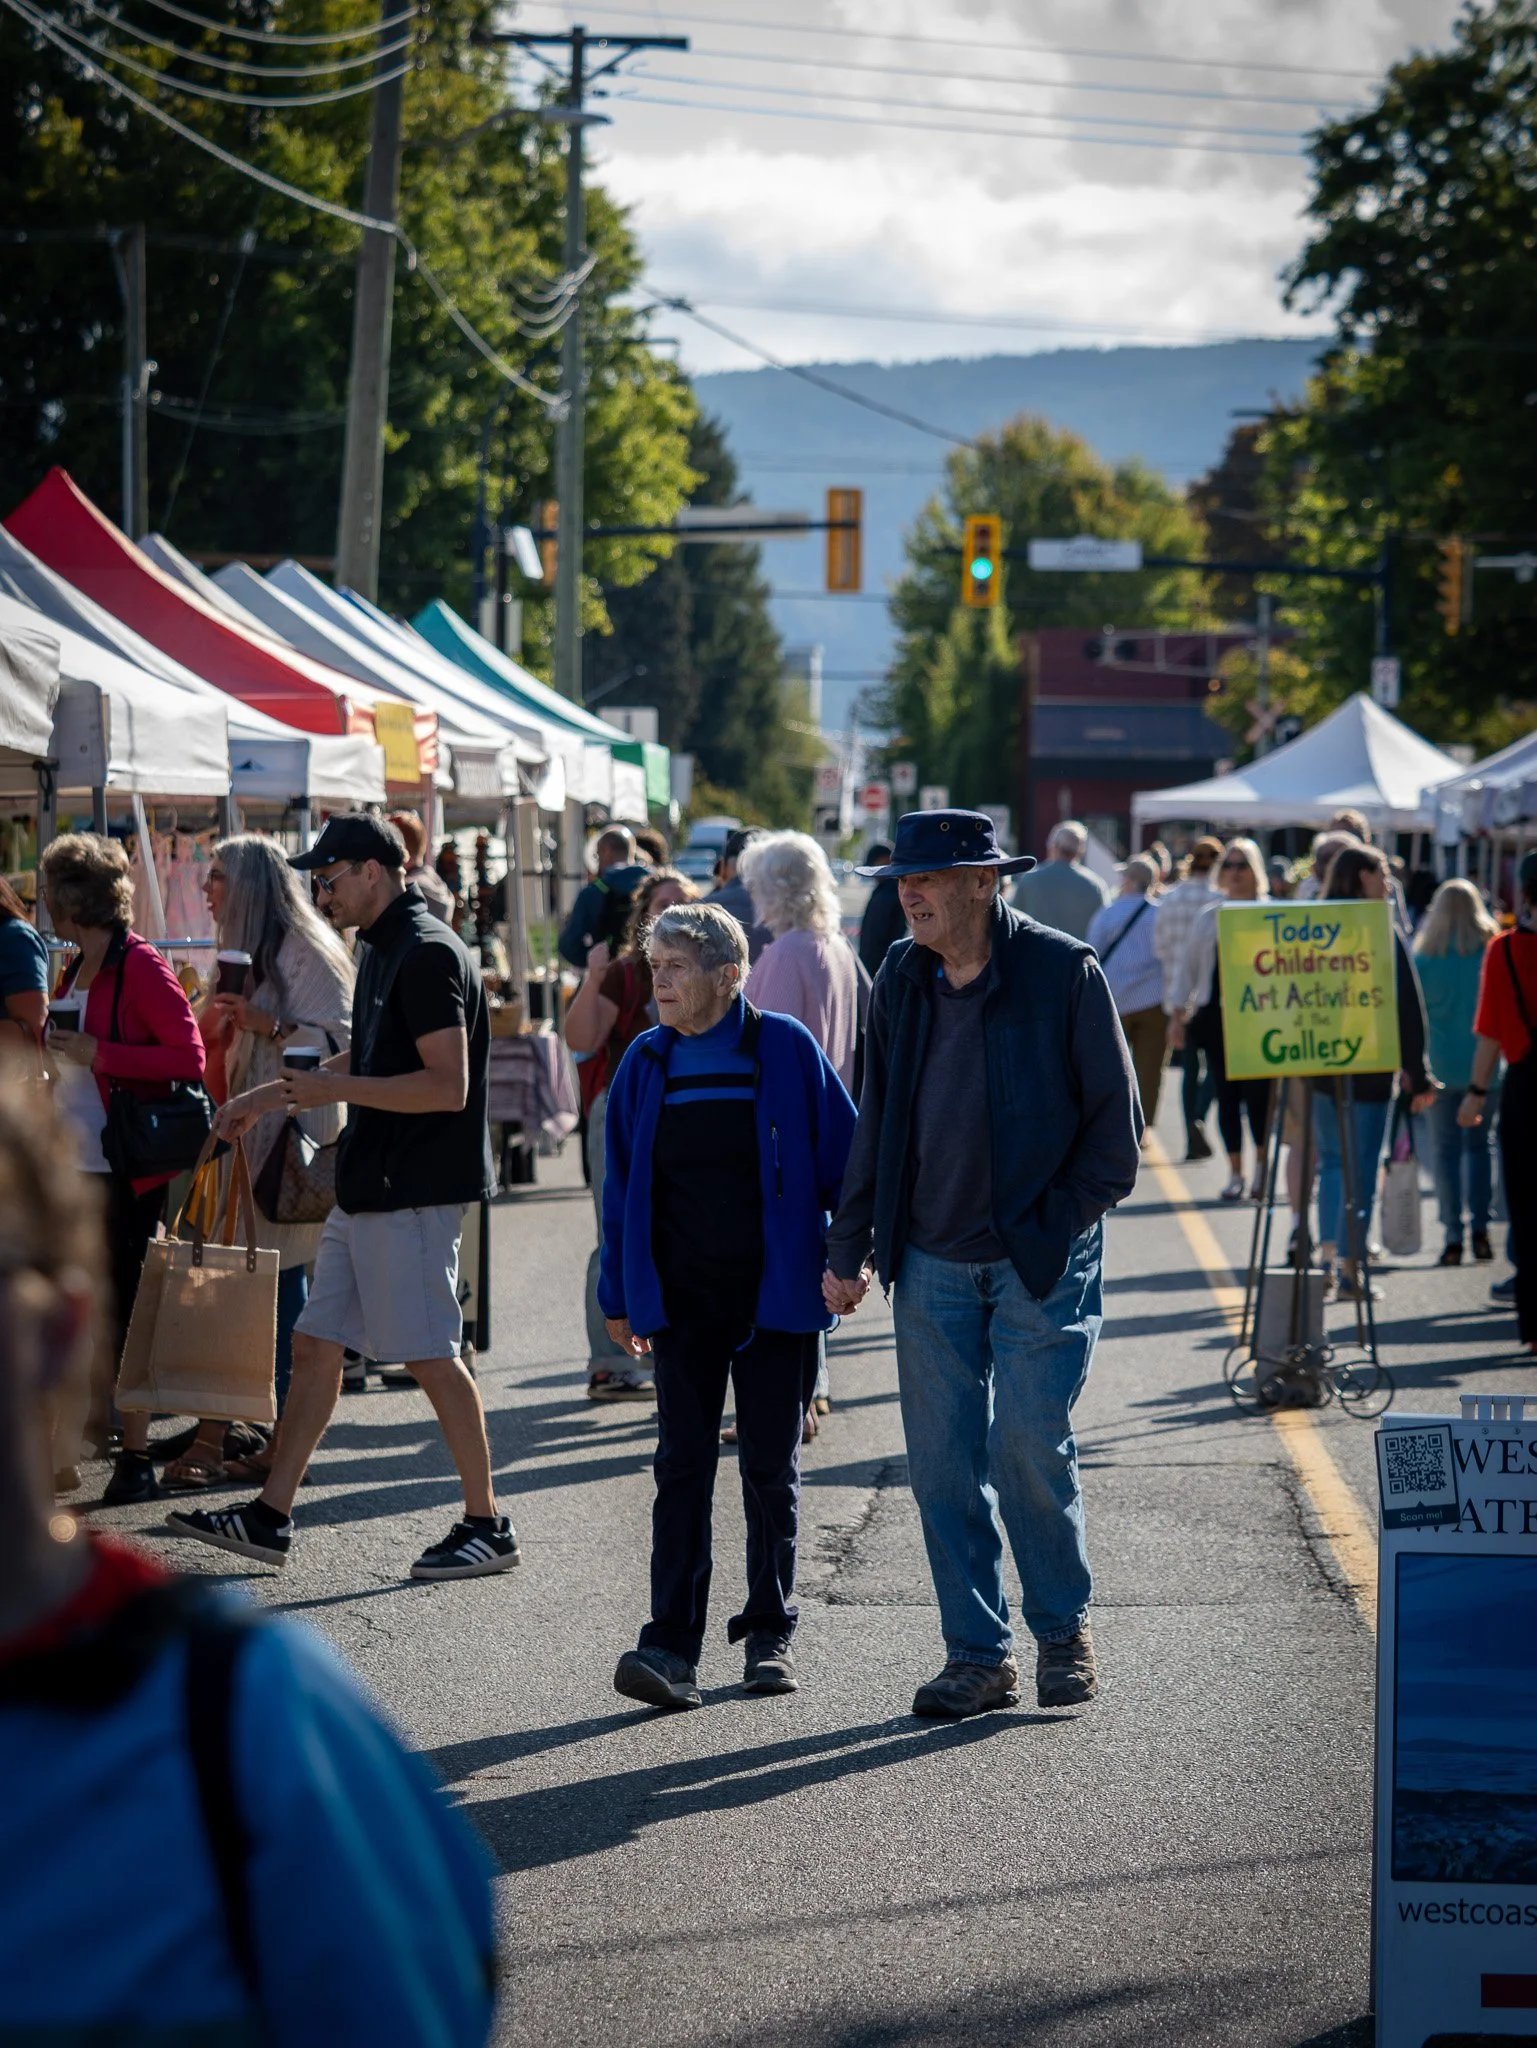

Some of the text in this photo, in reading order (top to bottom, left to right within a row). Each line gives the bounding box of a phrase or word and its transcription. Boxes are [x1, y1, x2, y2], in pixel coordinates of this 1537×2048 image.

[1263, 913, 1342, 950] Today
[1239, 981, 1386, 1013] Art Activities
[1261, 1028, 1363, 1067] Gallery
[1454, 1438, 1537, 1475] WES
[1400, 1510, 1443, 1522] Scan me!
[1416, 1498, 1537, 1534] ATE
[1398, 1898, 1537, 1926] westcoas
